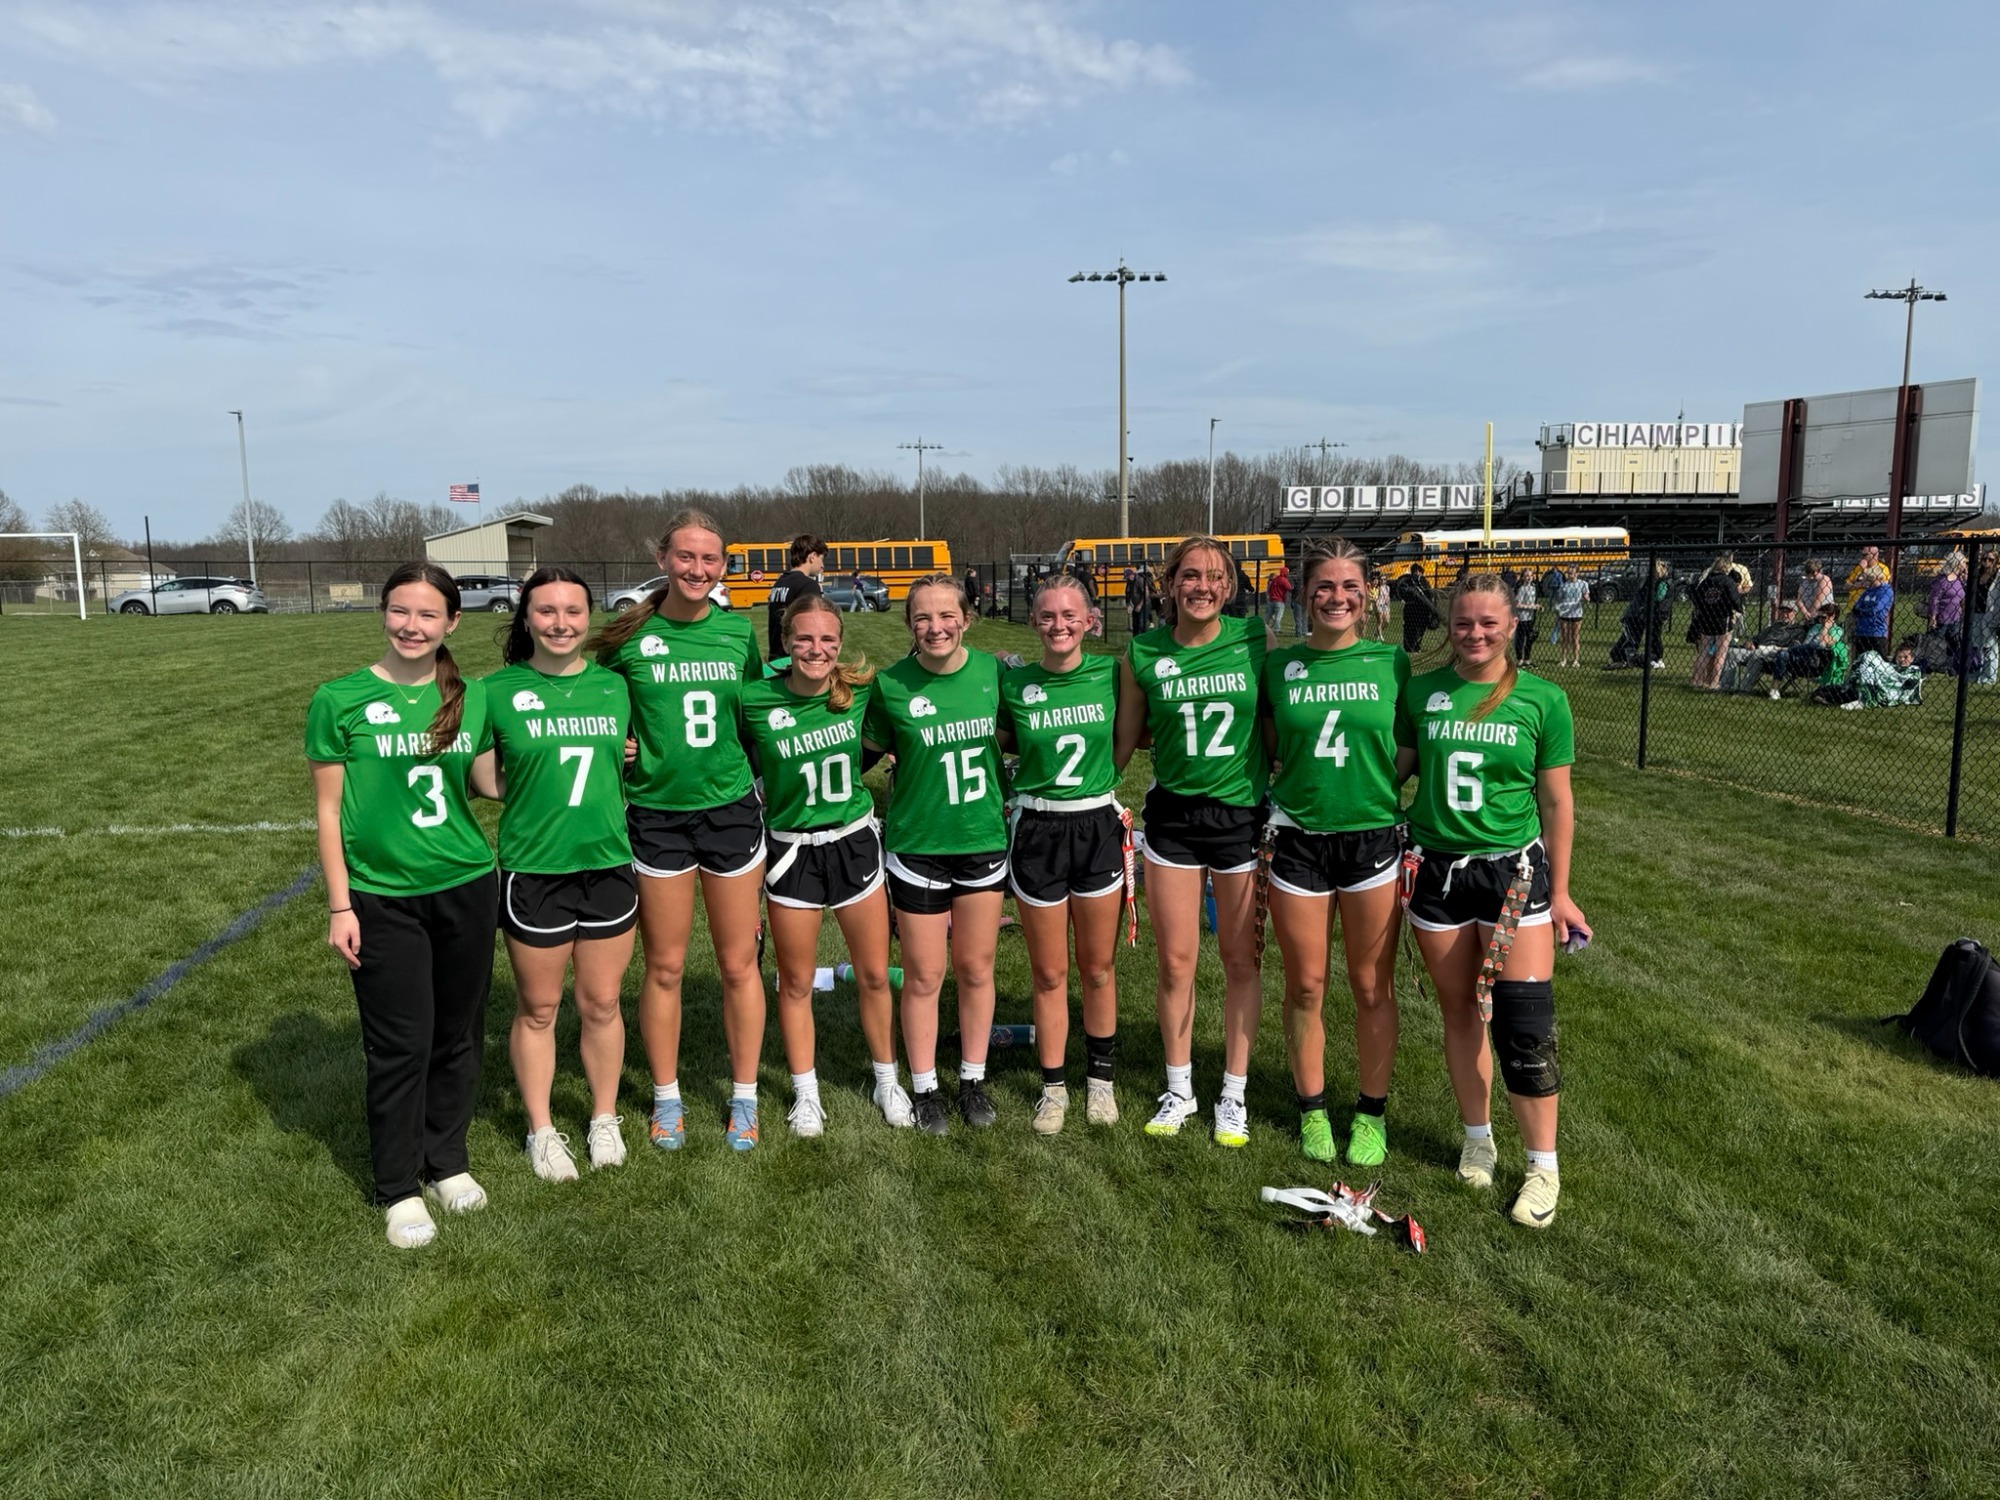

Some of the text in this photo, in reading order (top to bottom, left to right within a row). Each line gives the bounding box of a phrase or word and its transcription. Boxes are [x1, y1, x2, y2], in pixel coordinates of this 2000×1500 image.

[1577, 425, 1743, 446] CHAMPI
[1290, 486, 1471, 509] GOLDEN
[651, 661, 737, 682] WARRIORS
[1161, 673, 1247, 699] WARRIORS
[1290, 683, 1379, 705] WARRIORS
[526, 717, 618, 738] WARRIORS
[683, 691, 717, 748] 8
[920, 718, 995, 747] WARRIORS
[1028, 704, 1105, 730] WARRIORS
[1177, 701, 1235, 757] 12
[1428, 721, 1517, 746] WARRIORS
[375, 732, 472, 757] WARRRS
[776, 719, 857, 760] WARRIORS
[1314, 710, 1350, 768] 4
[560, 746, 595, 807] 7
[940, 747, 987, 805] 15
[1056, 734, 1086, 786] 2
[798, 752, 853, 806] 10
[1447, 750, 1484, 812] 6
[408, 765, 448, 829] 3
